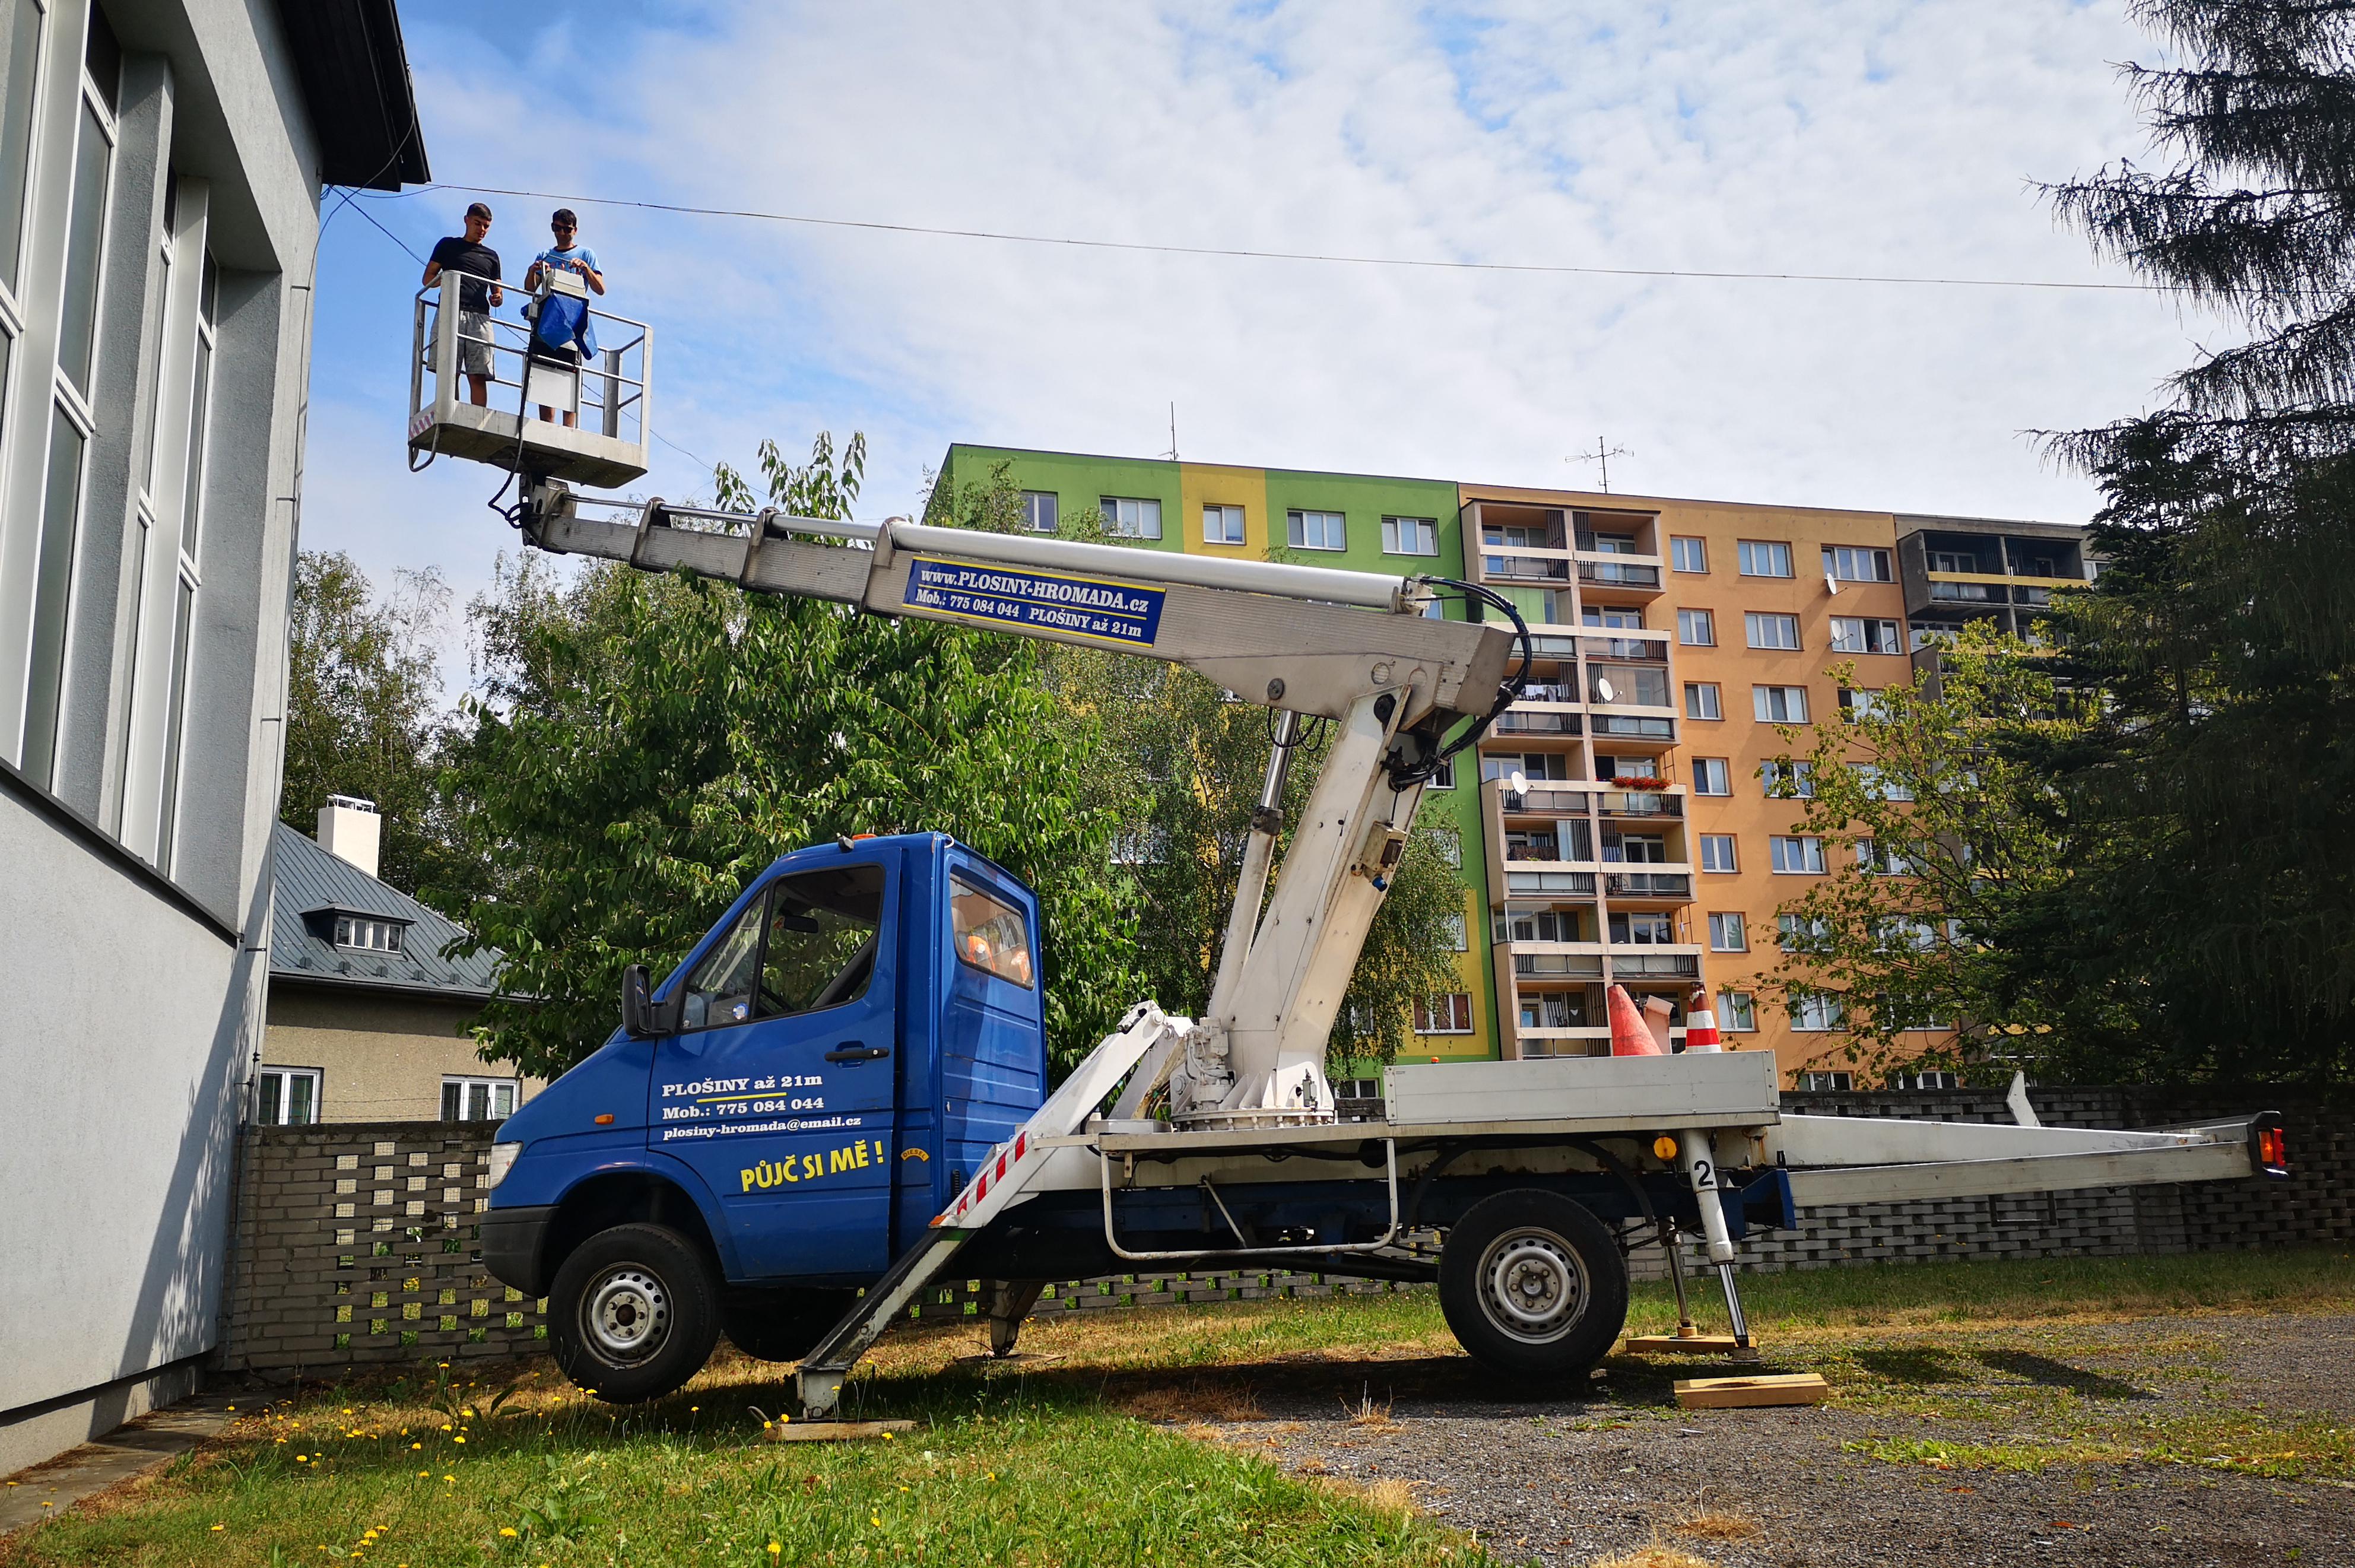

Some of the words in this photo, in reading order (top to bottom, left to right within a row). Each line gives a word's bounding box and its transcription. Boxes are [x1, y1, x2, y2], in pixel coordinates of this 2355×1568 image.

[921, 569, 1149, 613] www.PLOSINY-HROMADA.cz
[915, 589, 946, 606] Mob.:
[950, 595, 971, 610] 775
[972, 598, 995, 614] 084
[996, 602, 1020, 618] 044
[1028, 607, 1091, 629] PLOŠINY
[1092, 617, 1109, 632] až
[1111, 621, 1142, 637] 21m
[662, 1077, 750, 1097] PLOŠINY
[753, 1075, 776, 1090] až
[780, 1075, 823, 1088] 21m
[662, 1105, 710, 1120] Mob.:
[716, 1102, 748, 1115] 775
[753, 1099, 786, 1113] 084
[791, 1097, 824, 1110] 044
[662, 1116, 862, 1141] plosiny-hromada@email.cz
[740, 1155, 799, 1192] PŮJČ
[802, 1154, 823, 1180] SI
[830, 1138, 869, 1174] MĚ
[874, 1140, 884, 1164] !
[902, 1148, 928, 1160] DIESEL
[1694, 1159, 1714, 1188] 2
